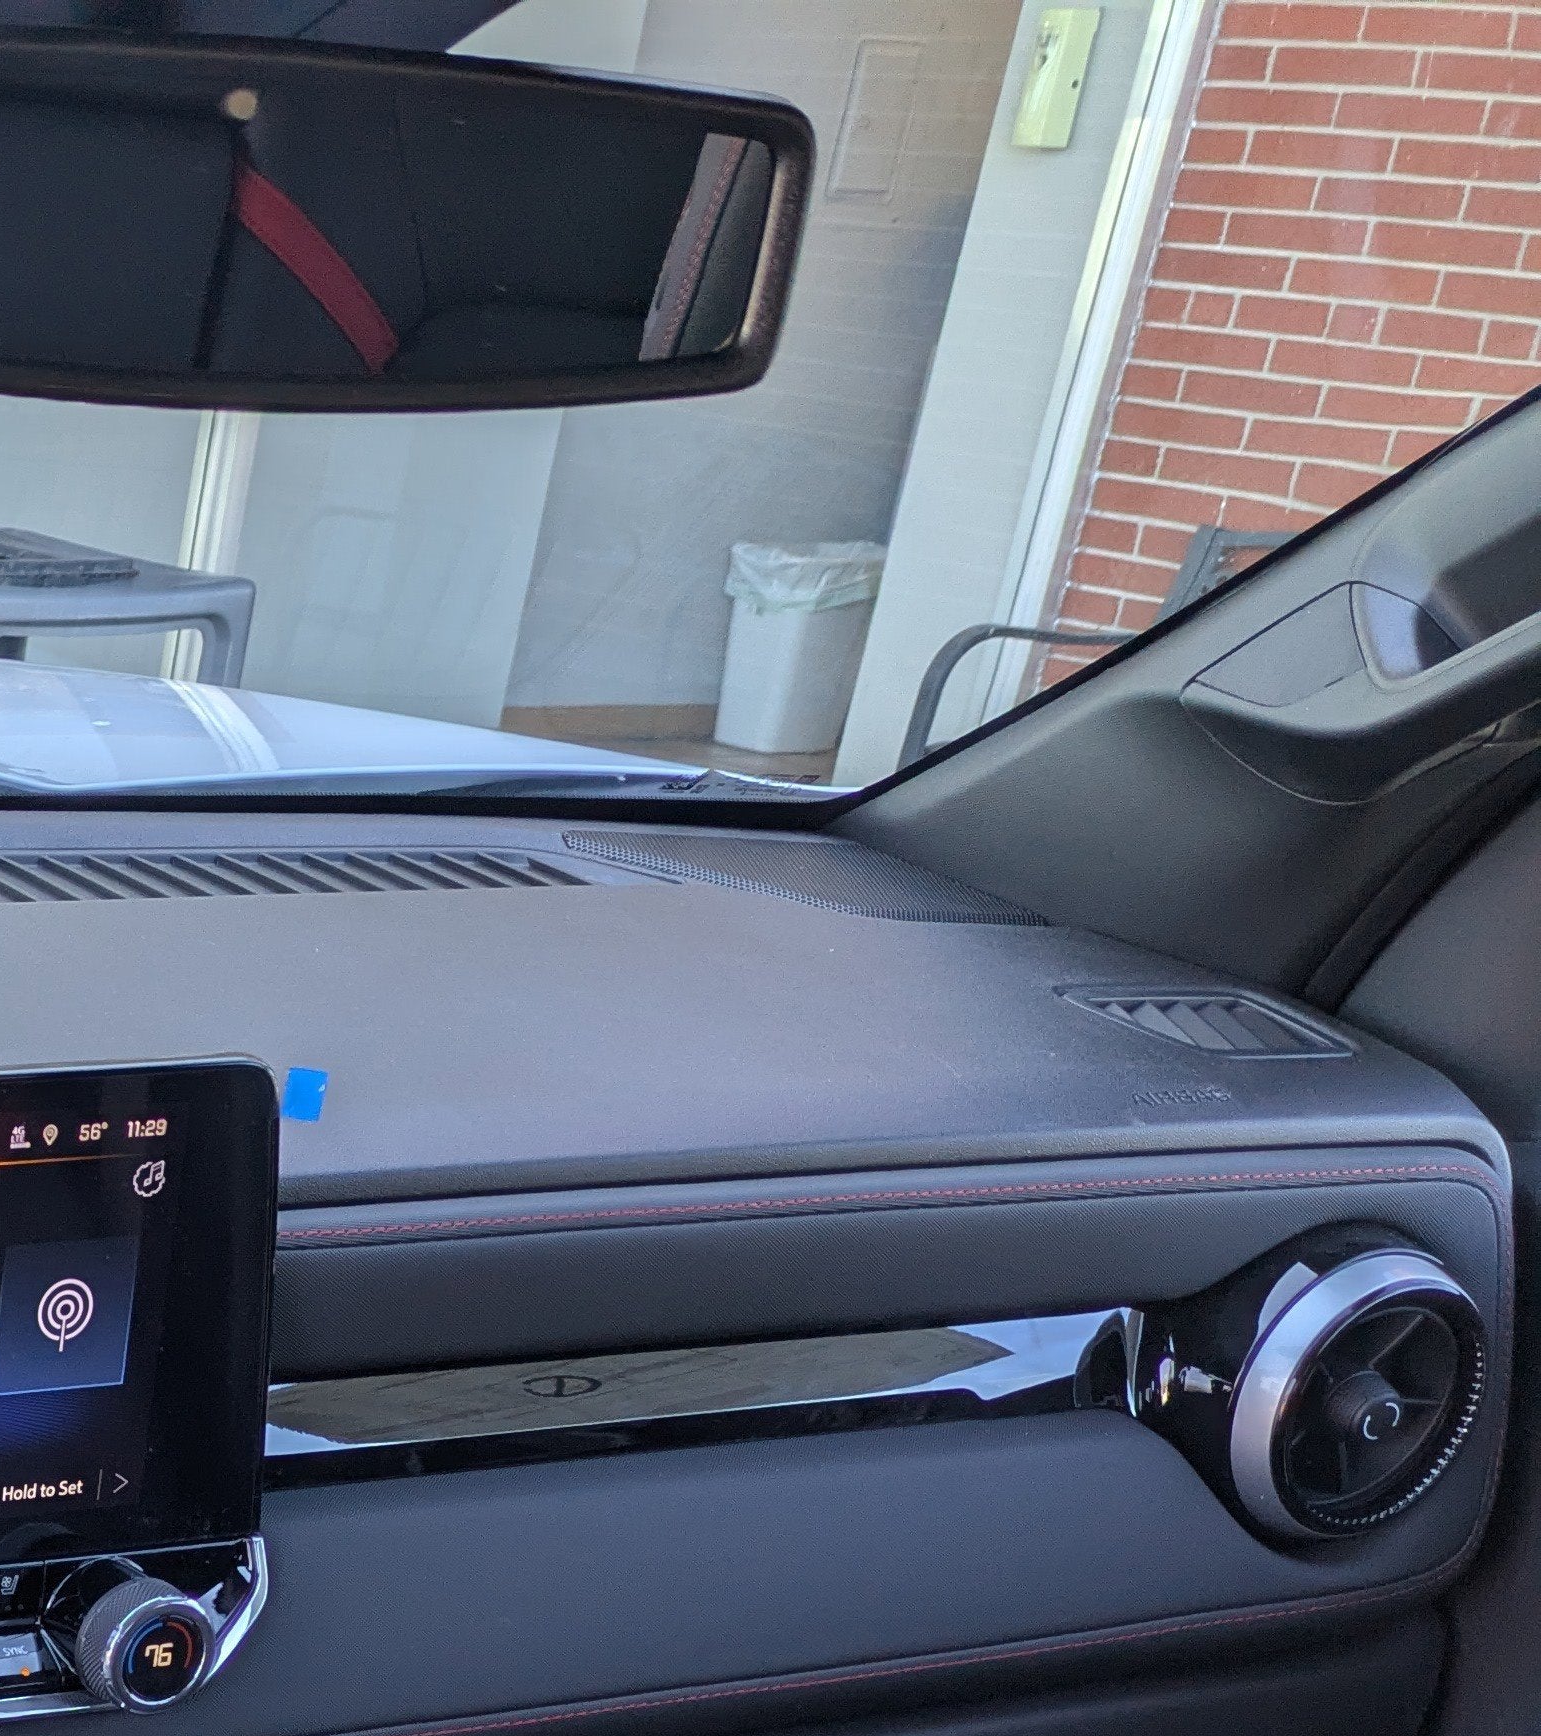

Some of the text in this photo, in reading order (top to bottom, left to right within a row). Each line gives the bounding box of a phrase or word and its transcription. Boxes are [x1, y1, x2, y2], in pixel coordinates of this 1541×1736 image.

[78, 1118, 168, 1142] 56° 11:29
[1, 1479, 84, 1503] Hold to Set
[2, 1645, 29, 1658] SYNC
[144, 1643, 174, 1668] 76
